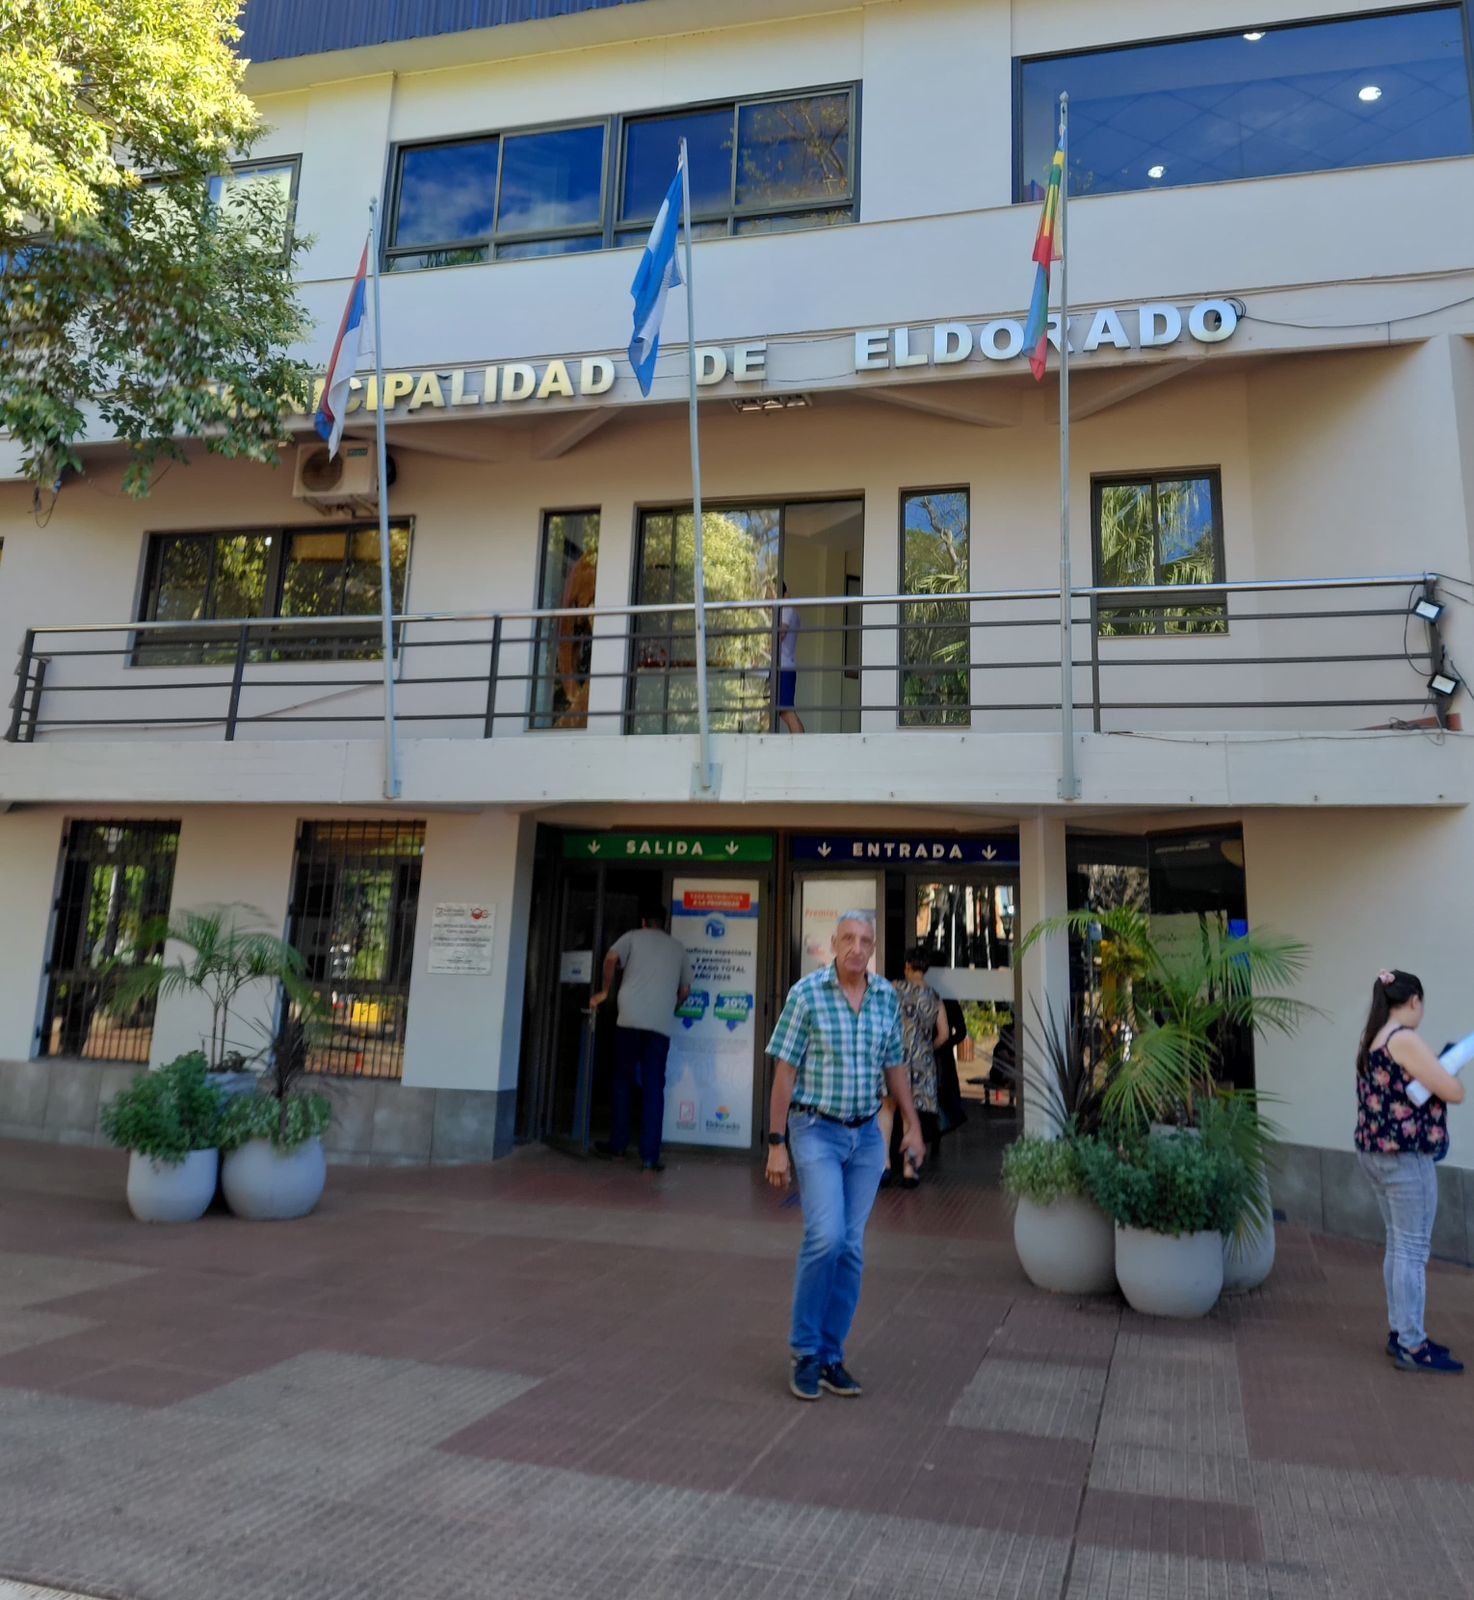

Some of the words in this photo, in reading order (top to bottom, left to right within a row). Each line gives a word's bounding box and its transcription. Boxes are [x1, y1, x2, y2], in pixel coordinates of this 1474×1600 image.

[206, 355, 616, 418] IIPALIDAD
[692, 340, 767, 387] DE
[854, 299, 1239, 371] ELDORADO
[626, 840, 704, 856] SALIDA
[852, 842, 963, 859] ENTRADA
[721, 965, 745, 974] TOTAL
